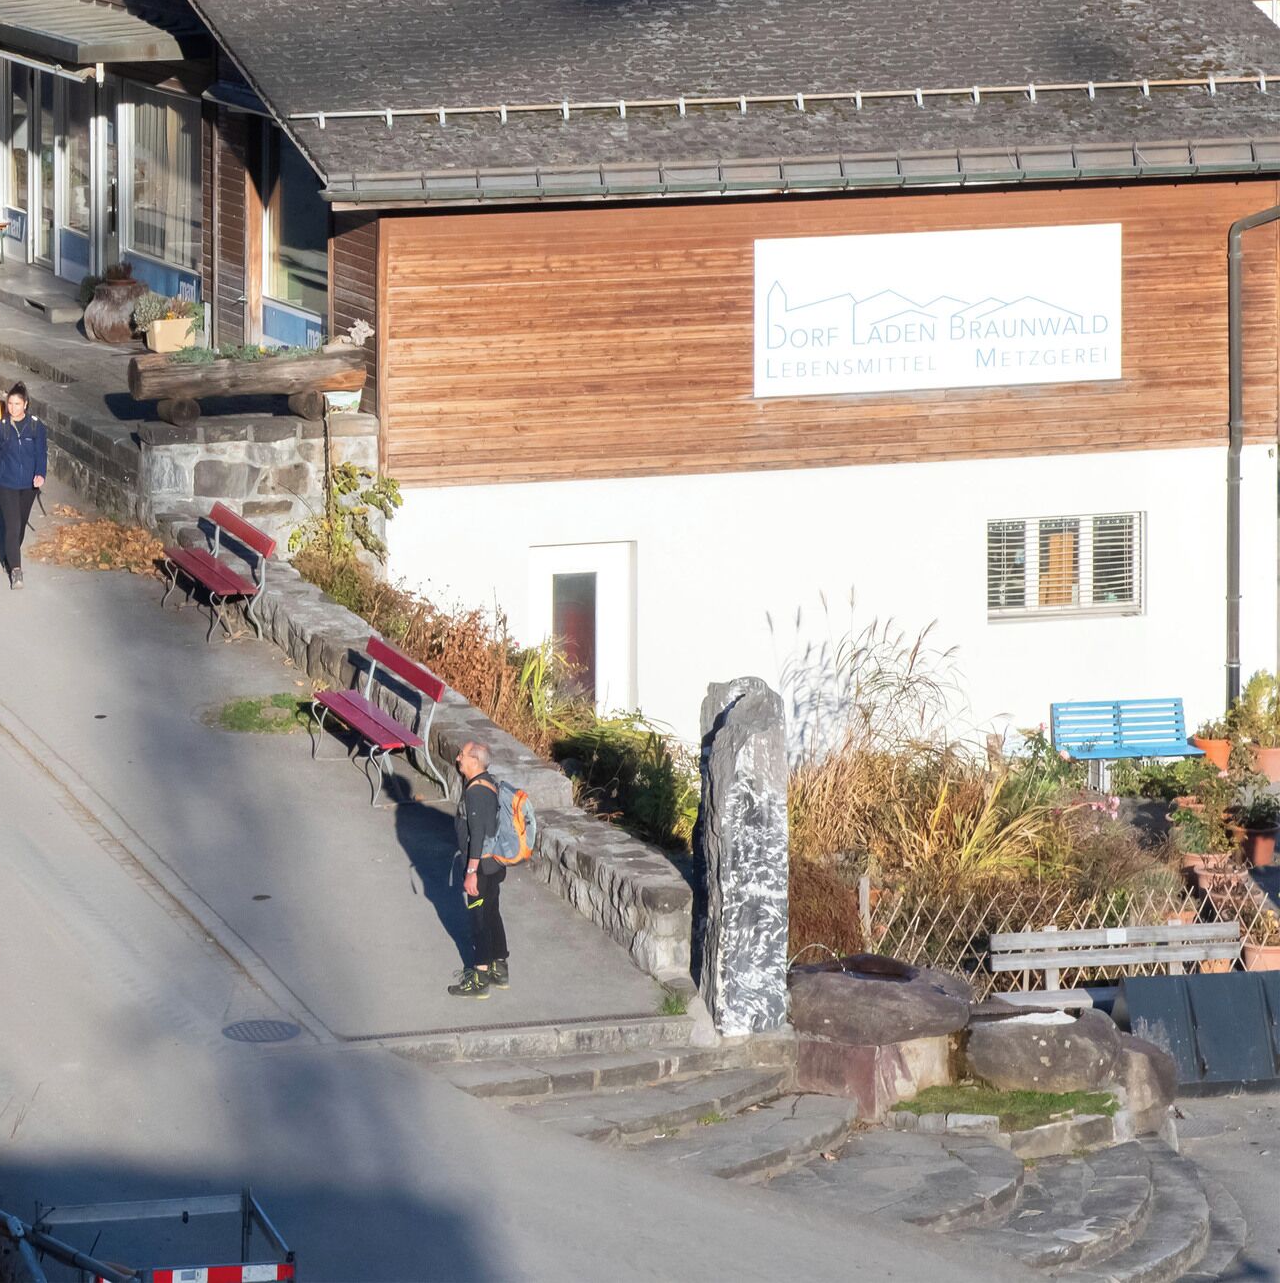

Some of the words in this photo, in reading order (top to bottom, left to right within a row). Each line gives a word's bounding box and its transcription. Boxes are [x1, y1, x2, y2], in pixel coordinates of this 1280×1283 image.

[307, 328, 322, 350] ma
[766, 323, 839, 349] DORF
[852, 310, 935, 345] LADEN
[950, 314, 1108, 340] BRAUNWALD
[766, 356, 936, 378] LEBENSMITTEL
[975, 346, 1107, 367] METZGEREI
